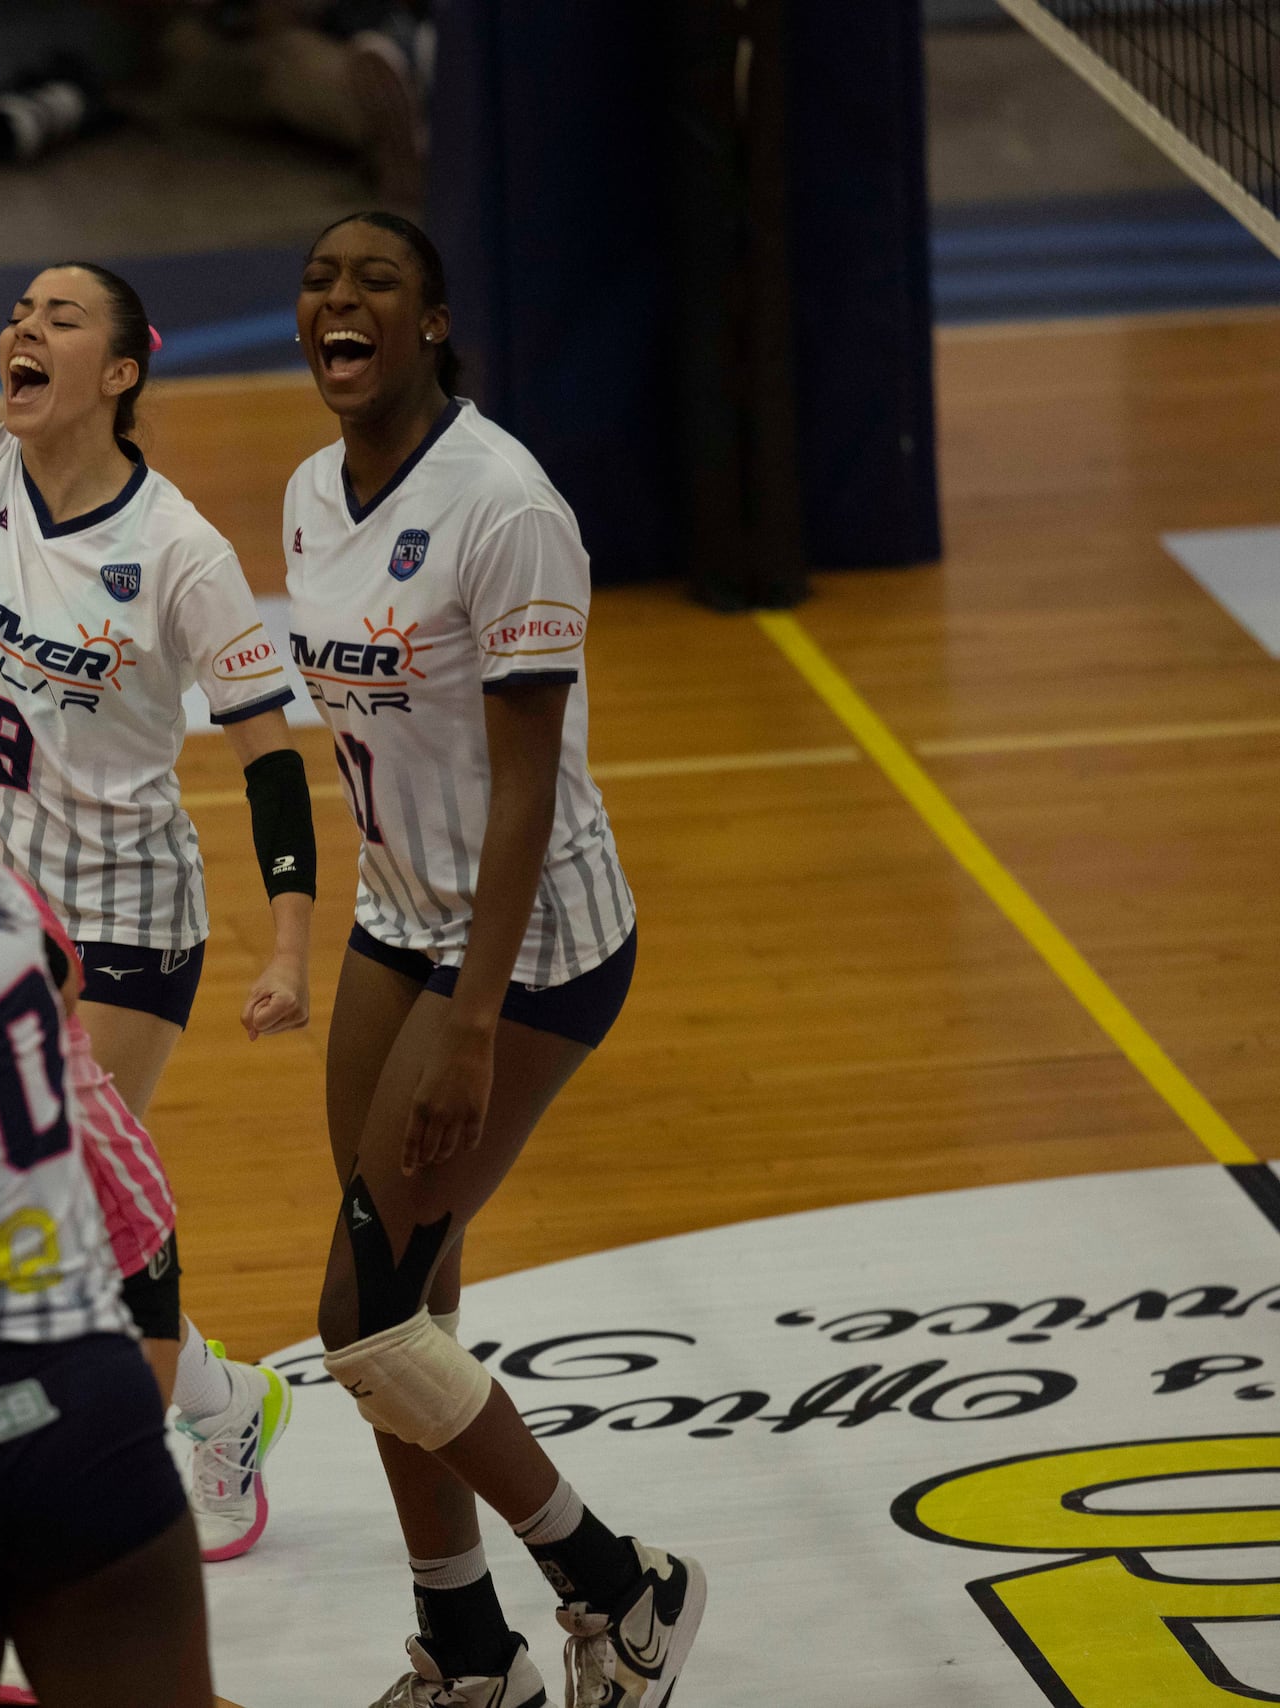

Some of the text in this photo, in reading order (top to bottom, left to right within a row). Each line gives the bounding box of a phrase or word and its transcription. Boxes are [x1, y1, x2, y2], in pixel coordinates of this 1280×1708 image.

[103, 570, 138, 590] METS
[775, 1283, 1280, 1342] rvice,
[525, 1359, 1078, 1433] Office
